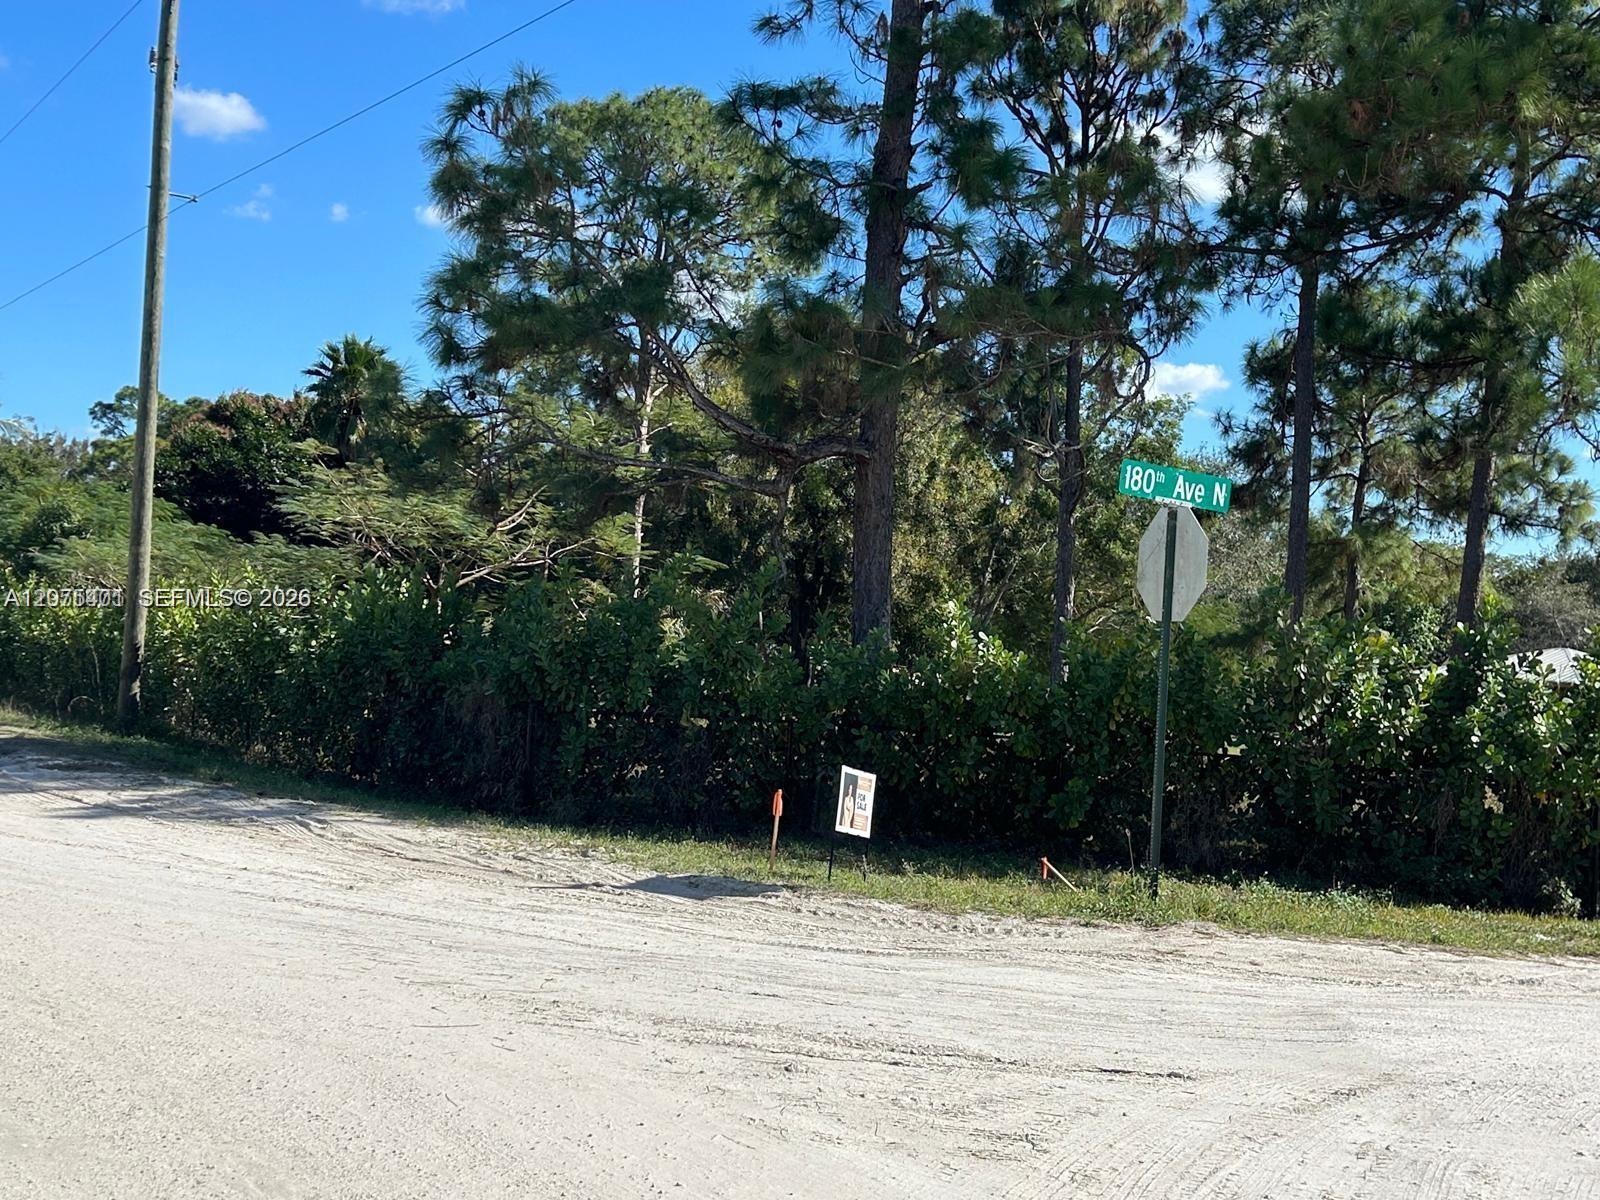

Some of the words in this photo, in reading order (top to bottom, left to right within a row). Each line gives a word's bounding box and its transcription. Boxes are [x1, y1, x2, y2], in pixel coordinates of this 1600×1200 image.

[1125, 464, 1166, 494] 180th
[1172, 474, 1205, 503] Ave
[1212, 481, 1227, 507] N
